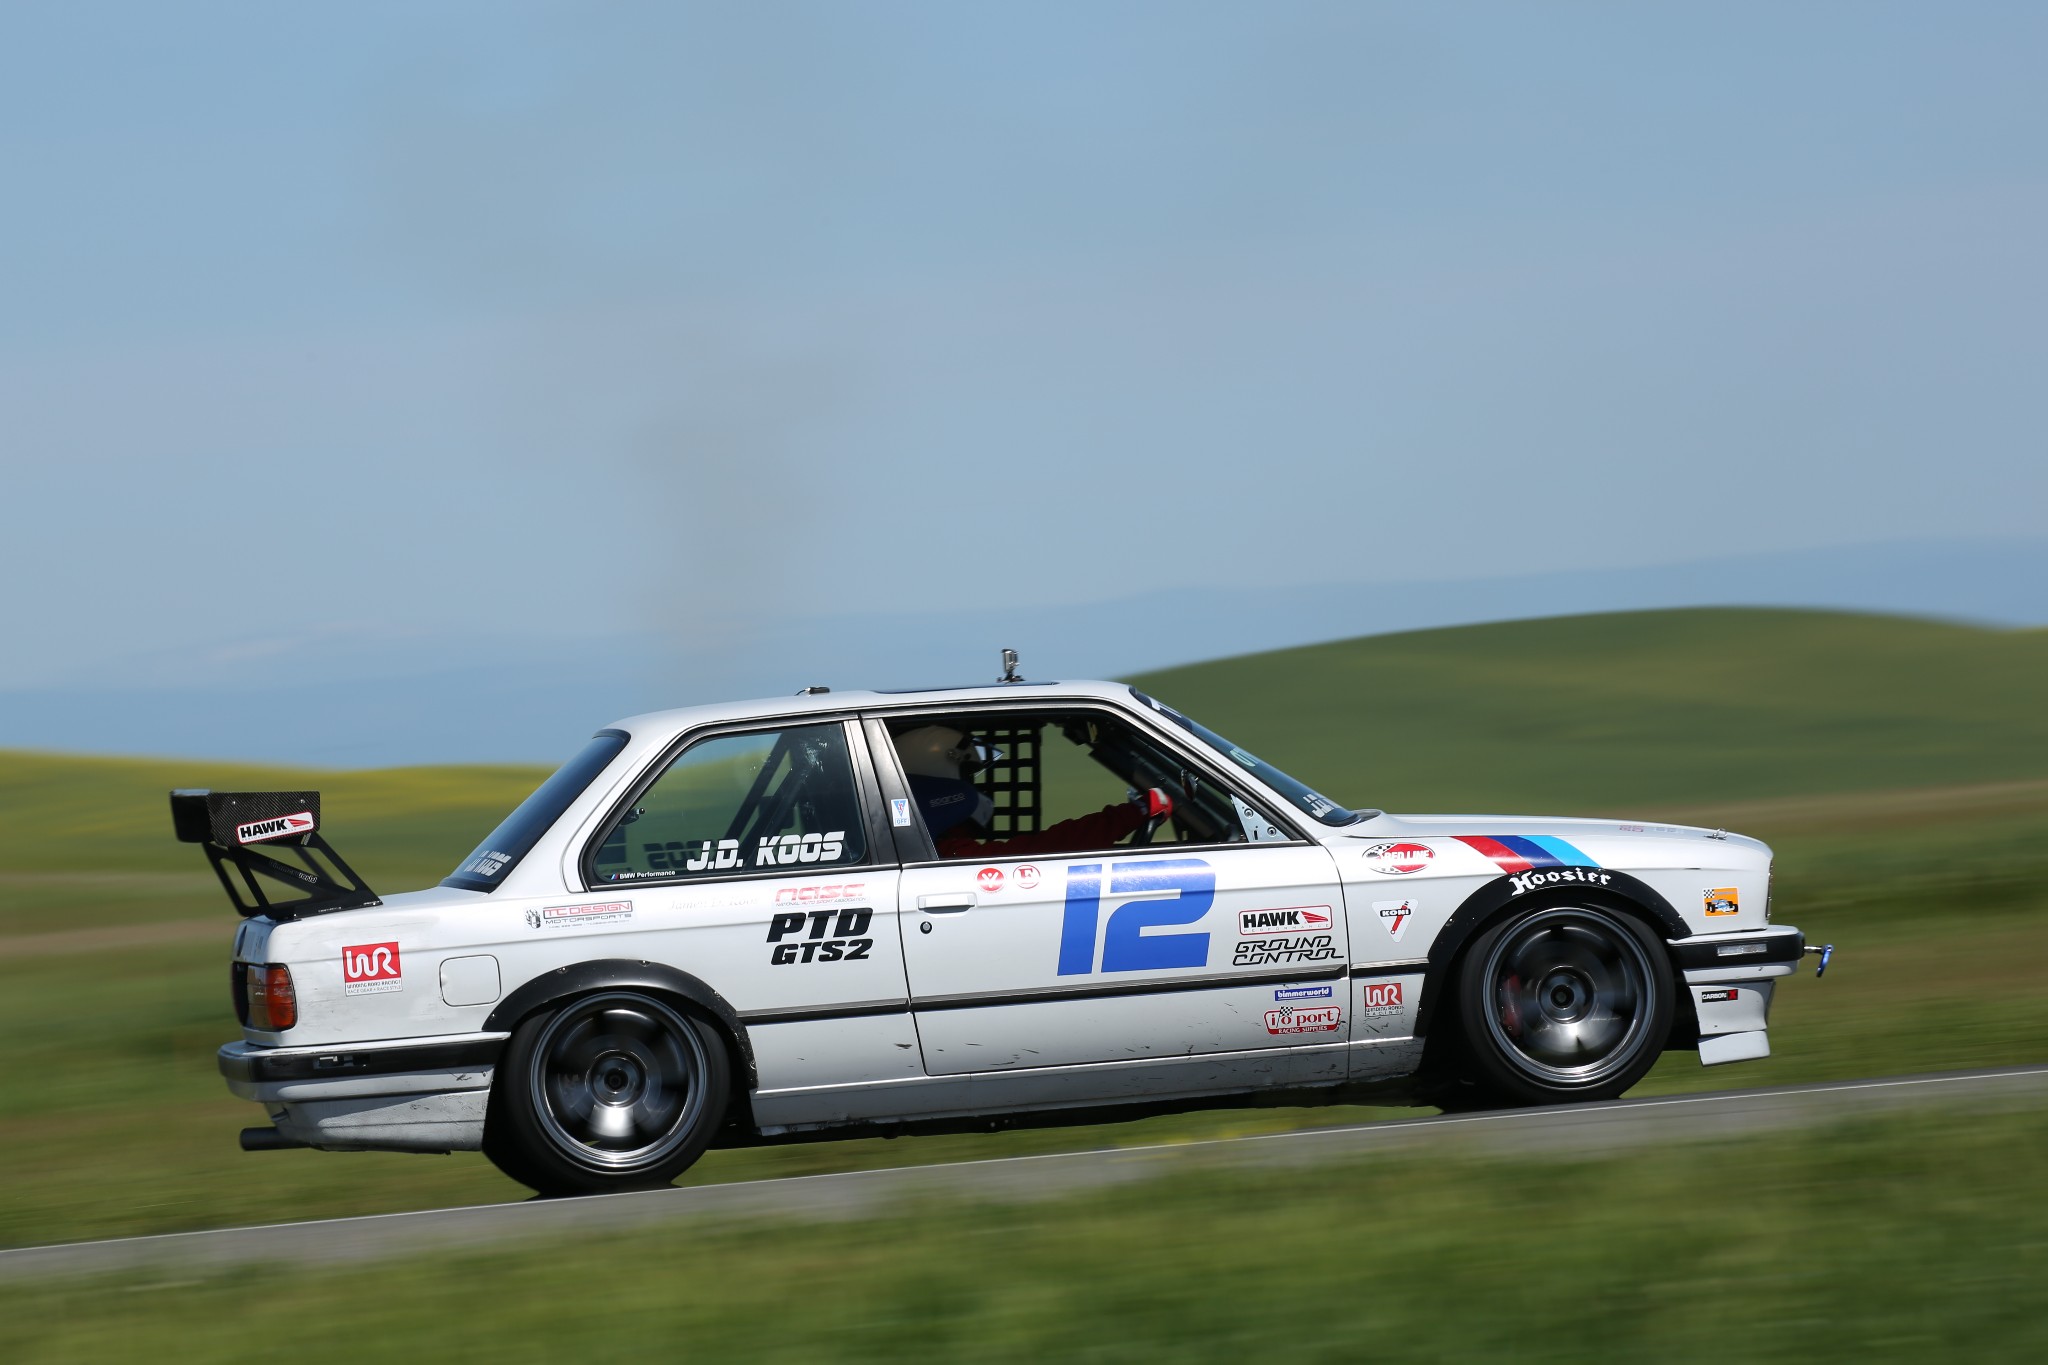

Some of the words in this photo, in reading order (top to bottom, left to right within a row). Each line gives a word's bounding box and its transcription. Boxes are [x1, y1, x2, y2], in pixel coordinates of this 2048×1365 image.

[240, 819, 288, 838] HAWK
[686, 839, 744, 871] J.D.
[756, 831, 845, 866] KOOS
[619, 872, 636, 880] BMW
[636, 870, 676, 878] Performance
[1508, 867, 1612, 896] Hoosier
[544, 908, 568, 917] TC
[570, 903, 630, 915] DESIGN
[1057, 858, 1216, 976] 12
[1381, 909, 1410, 917] KONI
[545, 914, 632, 925] MOTORSPORTS
[766, 907, 874, 943] PTD
[1243, 911, 1300, 928] HAWK
[1243, 924, 1329, 933] PERFORMANCE
[771, 939, 873, 965] GTS2
[1235, 935, 1332, 953] GROUND
[1232, 948, 1344, 966] CONTROL
[1277, 987, 1330, 998] bimmerworld
[1702, 992, 1727, 1000] CARBON
[1296, 1010, 1335, 1026] port
[1302, 1025, 1328, 1033] SUPPLIES
